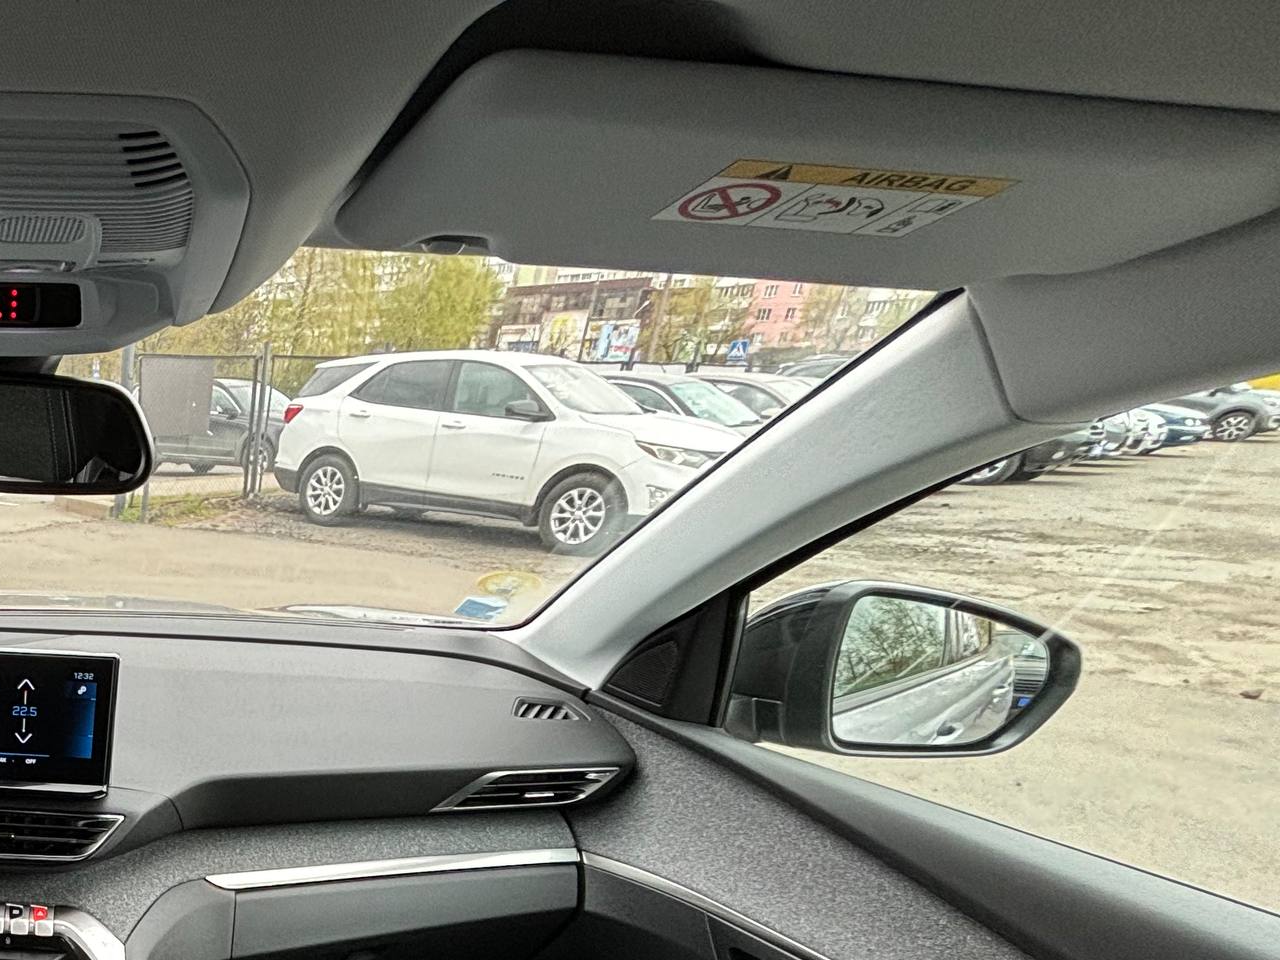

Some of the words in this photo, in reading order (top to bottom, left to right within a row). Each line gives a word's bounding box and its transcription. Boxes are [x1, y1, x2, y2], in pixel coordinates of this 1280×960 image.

[841, 171, 978, 193] AIRBAG
[74, 672, 94, 680] 12:32
[12, 706, 37, 717] 22.5
